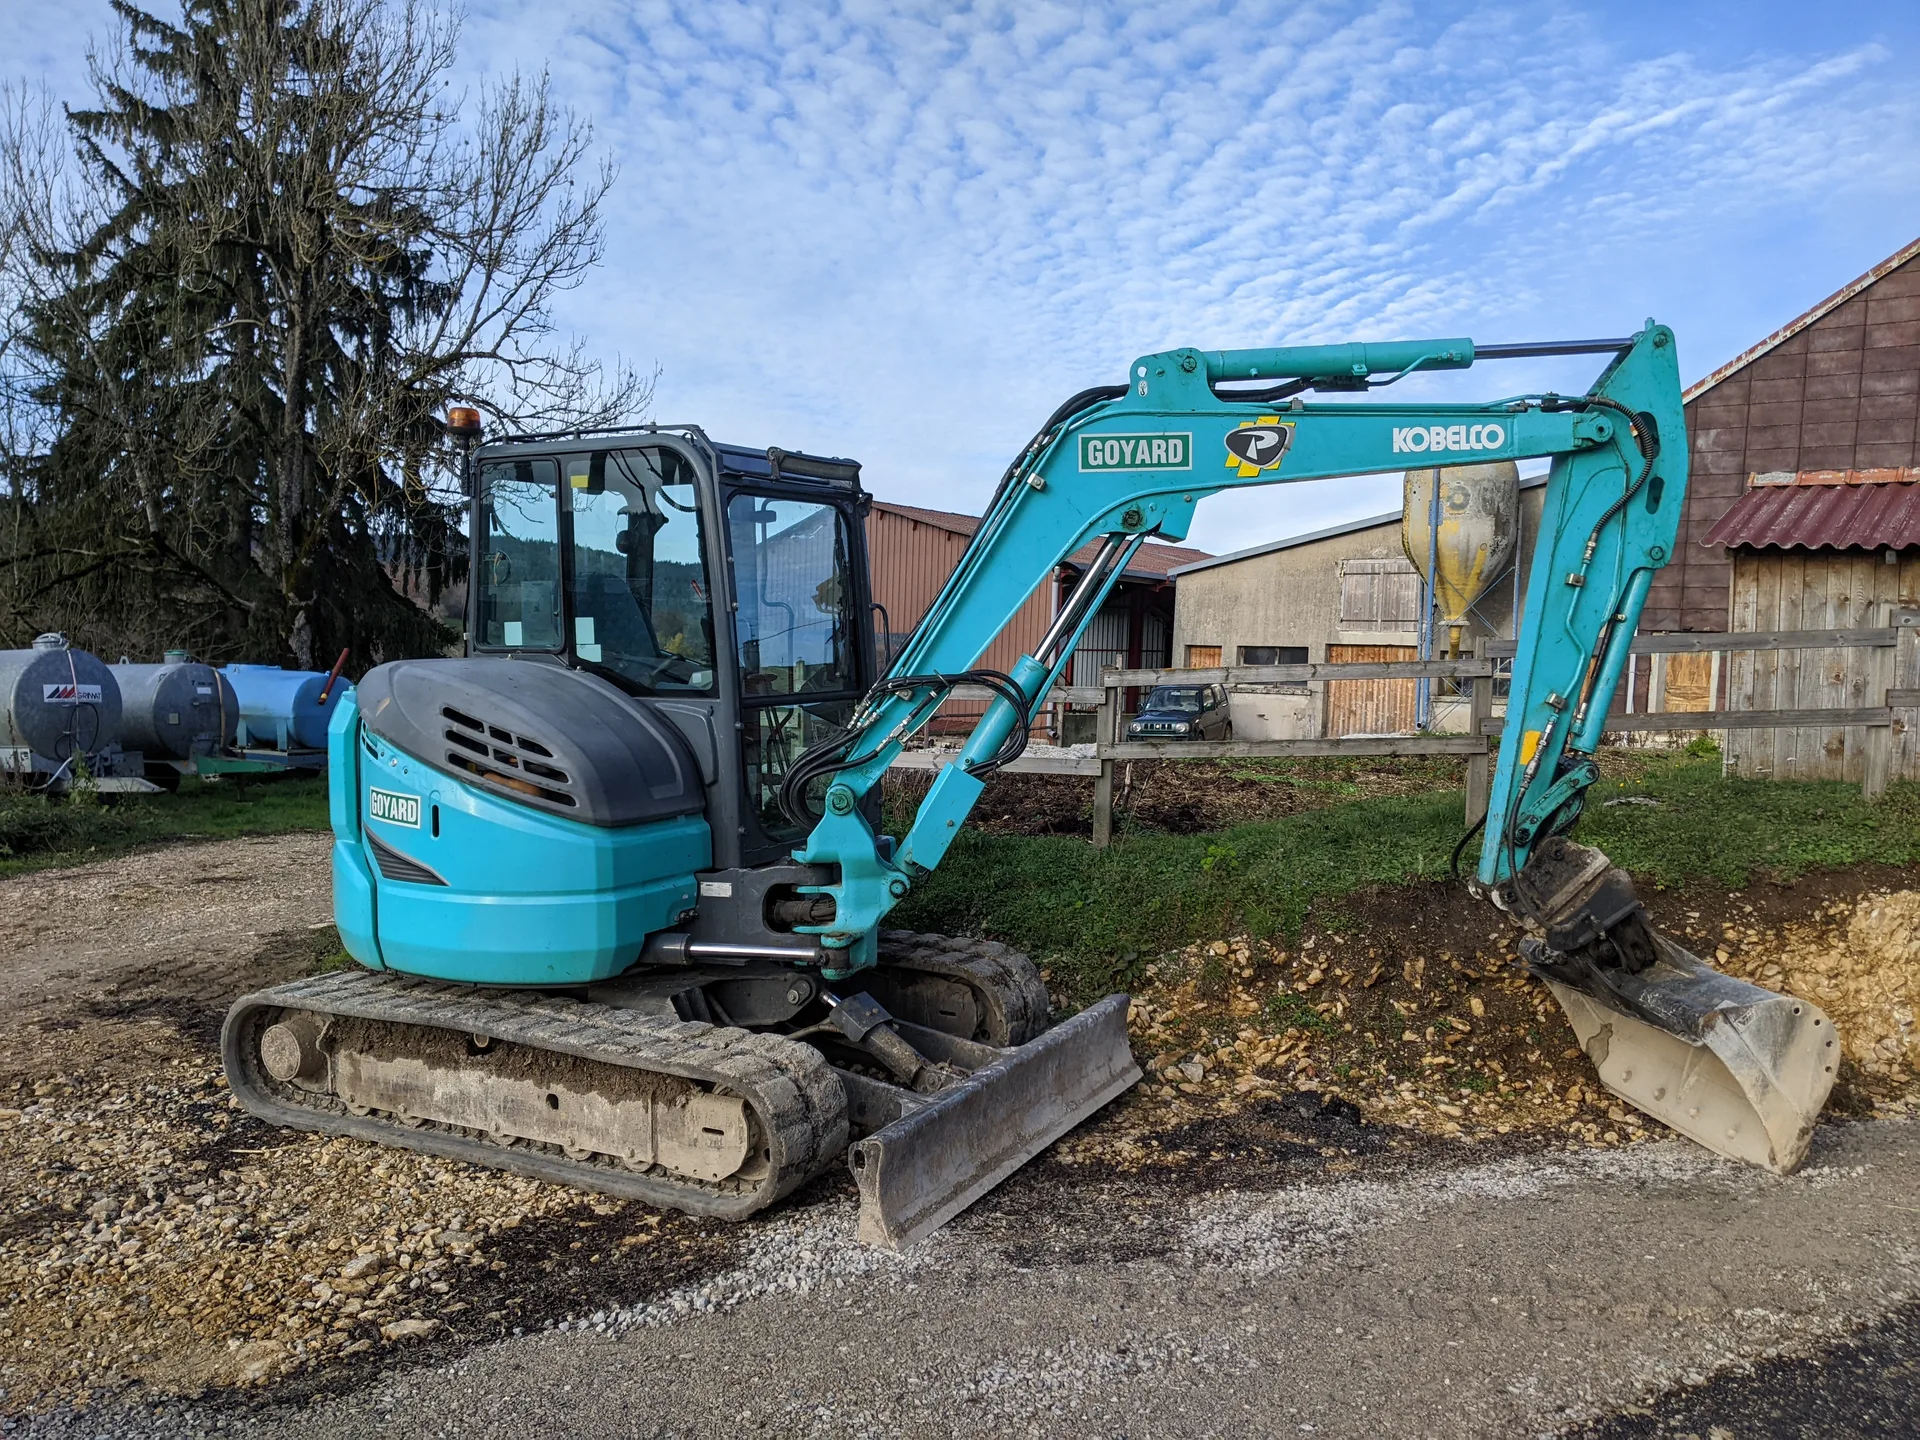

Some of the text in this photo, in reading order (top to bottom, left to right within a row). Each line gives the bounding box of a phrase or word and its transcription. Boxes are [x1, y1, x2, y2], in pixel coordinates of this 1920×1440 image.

[1087, 438, 1184, 466] GOYARD
[1392, 424, 1505, 453] KOBELCO
[371, 791, 417, 823] GOYARD
